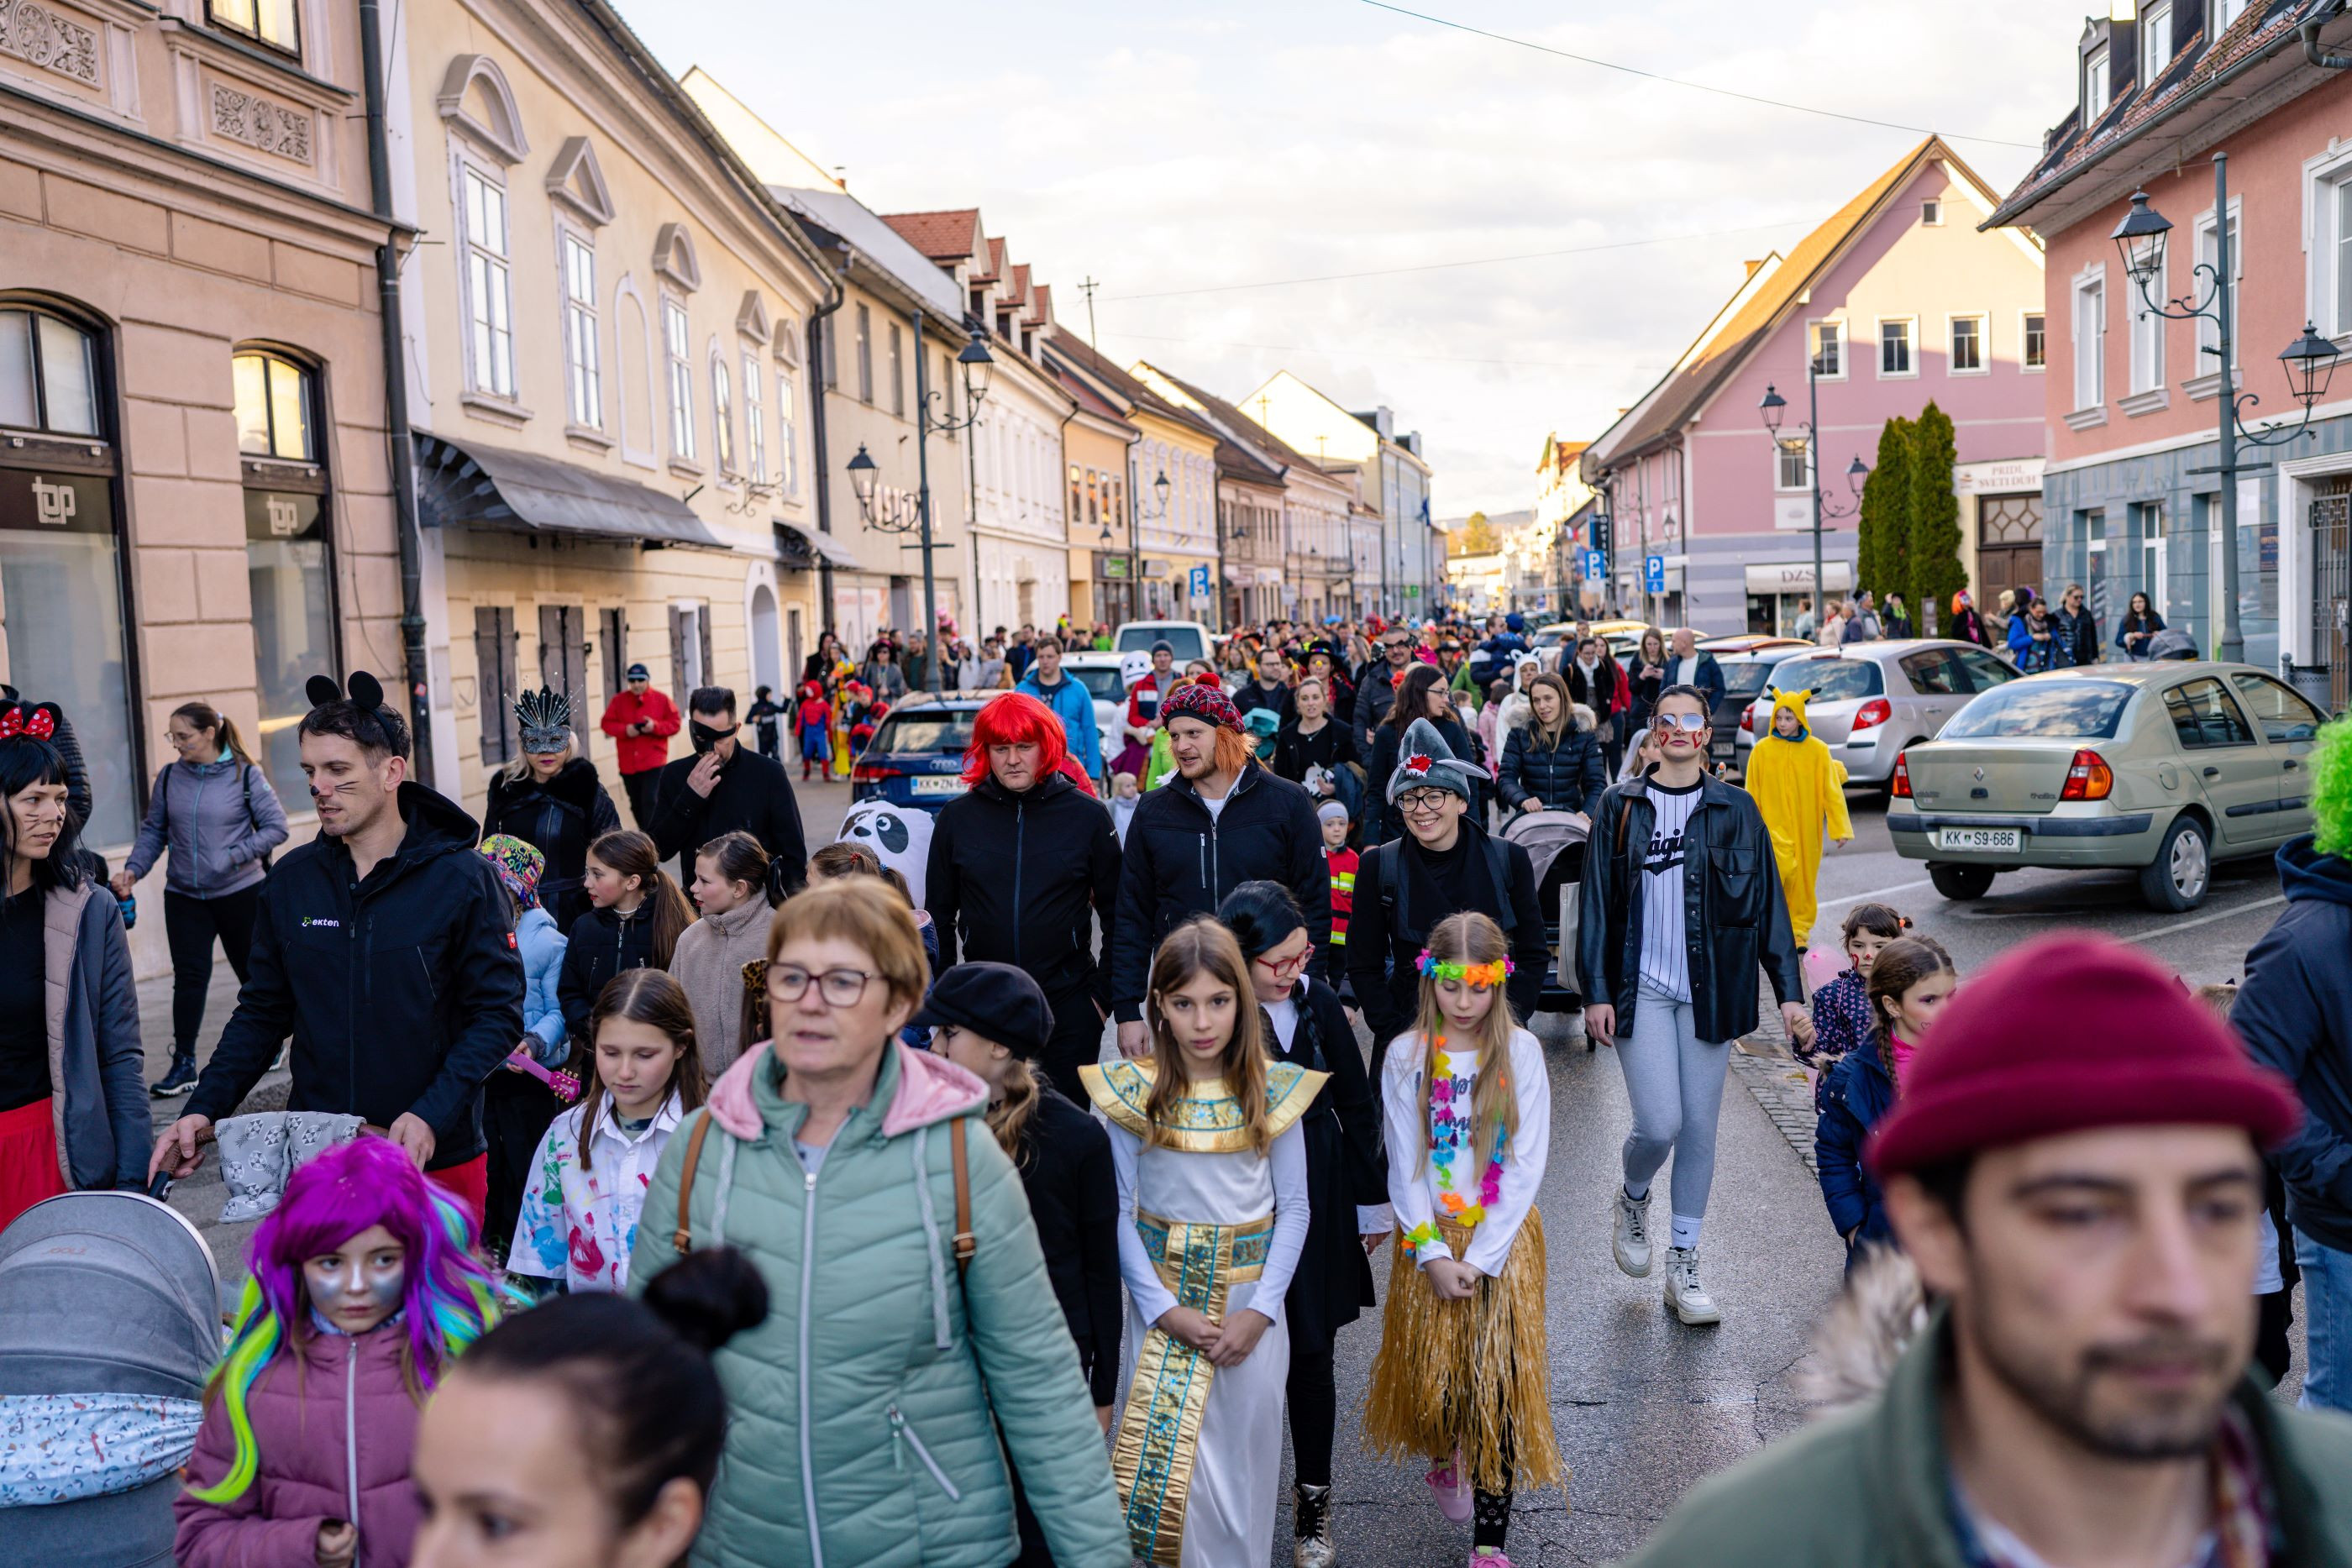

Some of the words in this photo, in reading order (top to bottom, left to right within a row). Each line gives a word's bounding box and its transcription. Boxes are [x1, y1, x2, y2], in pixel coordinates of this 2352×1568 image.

[32, 475, 76, 525] top
[266, 495, 298, 536] top
[1649, 558, 1661, 578] P
[1782, 569, 1817, 583] DZS
[1945, 831, 1961, 845] KK
[1974, 831, 2014, 846] S9-686
